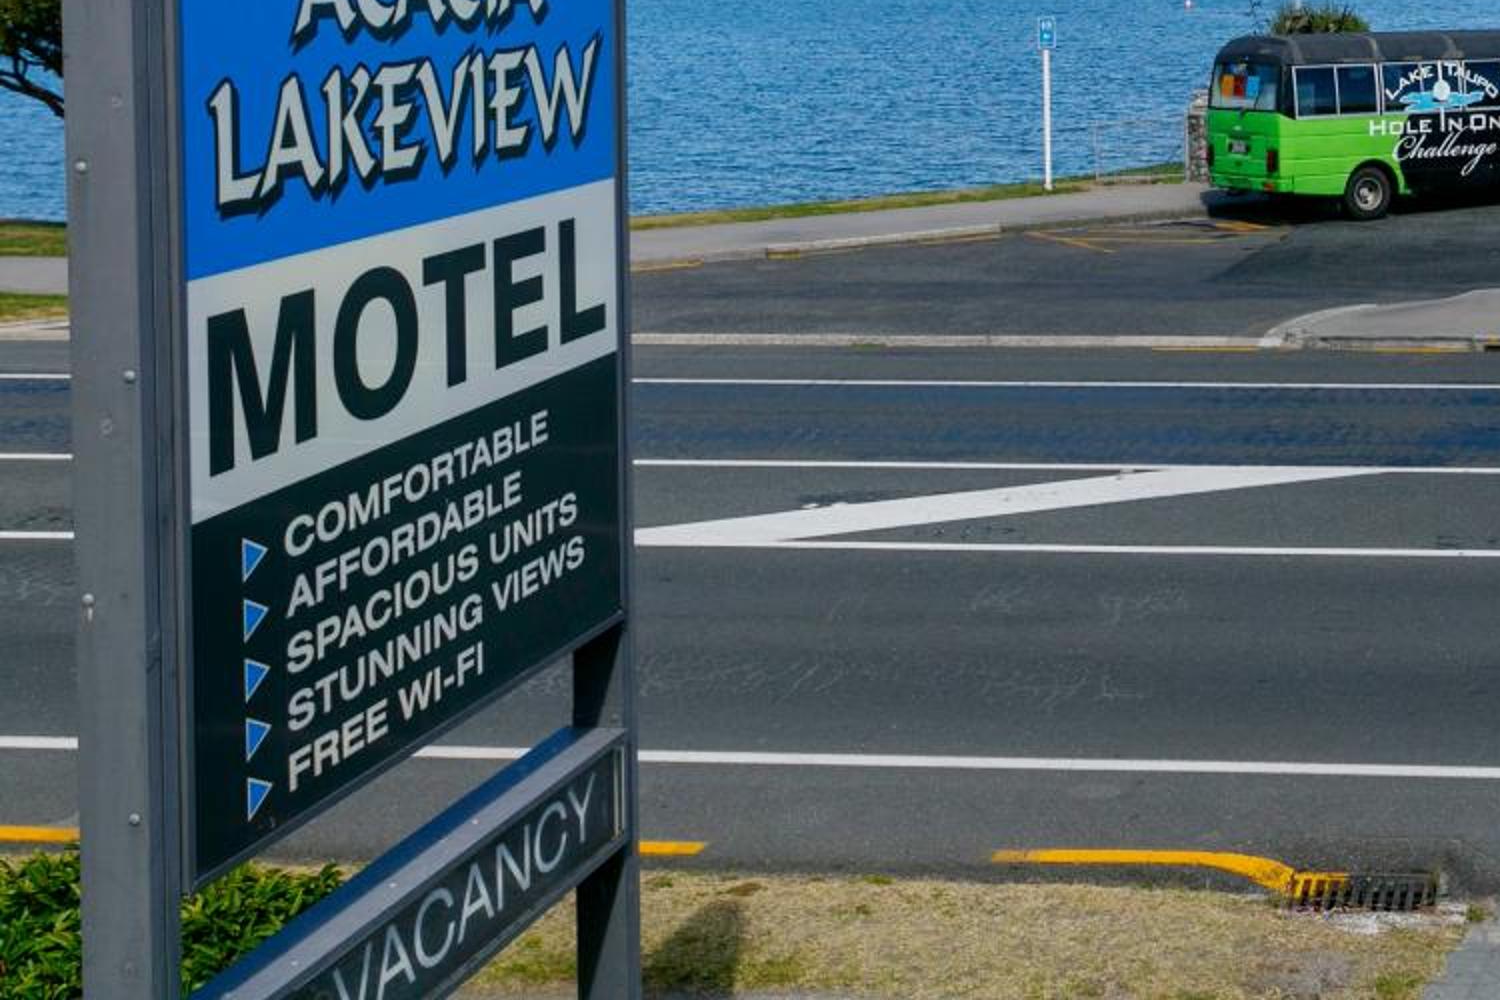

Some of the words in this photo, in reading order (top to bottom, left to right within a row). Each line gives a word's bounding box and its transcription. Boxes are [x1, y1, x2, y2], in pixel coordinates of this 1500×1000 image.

[207, 33, 601, 214] LAKEVIEW
[1369, 119, 1433, 137] HOLE
[1385, 65, 1434, 100] LAKE
[1444, 62, 1499, 99] TAUPO
[1392, 126, 1497, 176] Challenge
[206, 217, 606, 477] MOTEL
[284, 409, 549, 557] COMFORTABLE
[286, 471, 522, 619] AFFORDABLE
[287, 544, 479, 673] SPACIOUS
[489, 492, 577, 565] UNITS
[287, 593, 483, 731] STUNNING
[491, 535, 585, 612] VIEWS
[288, 698, 388, 792] FREE
[397, 641, 484, 720] WI-FI
[332, 771, 598, 1000] VACANCY
